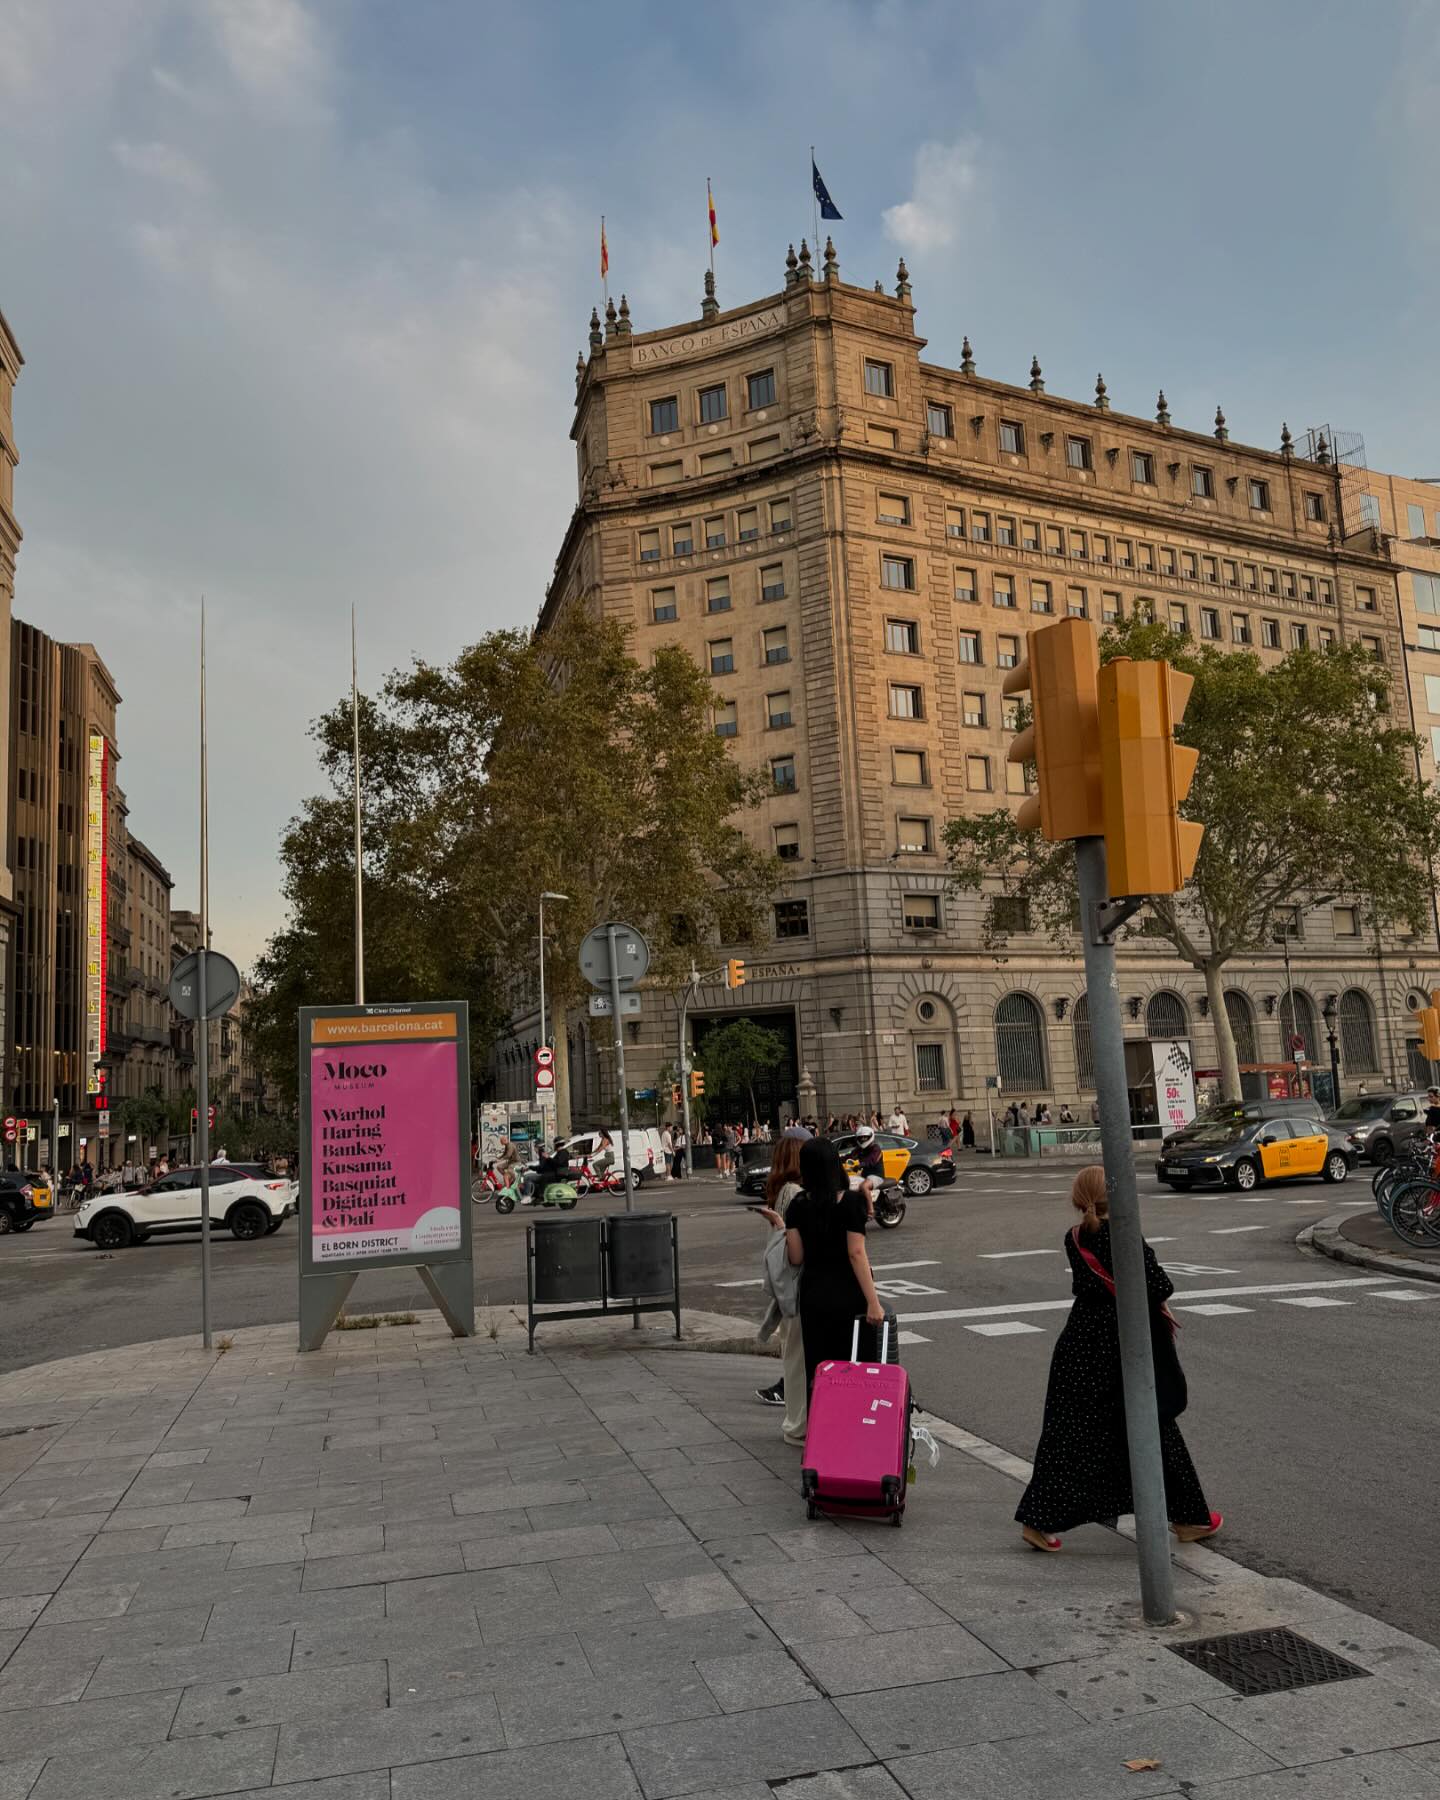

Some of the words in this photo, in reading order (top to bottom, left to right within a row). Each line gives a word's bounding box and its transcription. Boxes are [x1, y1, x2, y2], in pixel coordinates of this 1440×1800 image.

[638, 338, 695, 362] BANCO
[701, 336, 713, 347] DE
[721, 312, 779, 340] ESPAÑA
[751, 965, 797, 978] ESPAÑA
[327, 1021, 443, 1034] www.barcelona.cat
[323, 1062, 387, 1081] Moco
[334, 1082, 375, 1090] MUSEUM
[323, 1104, 386, 1122] Warhol
[323, 1123, 382, 1139] Haring
[323, 1141, 386, 1157] Banksy
[322, 1161, 392, 1175] Kusama
[322, 1175, 397, 1194] Basquiat
[322, 1192, 378, 1212] Digital
[381, 1192, 406, 1206] art
[322, 1215, 338, 1228] &
[340, 1210, 374, 1227] Dalí
[321, 1242, 331, 1251] EL
[333, 1241, 359, 1250] BORN
[361, 1237, 398, 1248] DISTRICT
